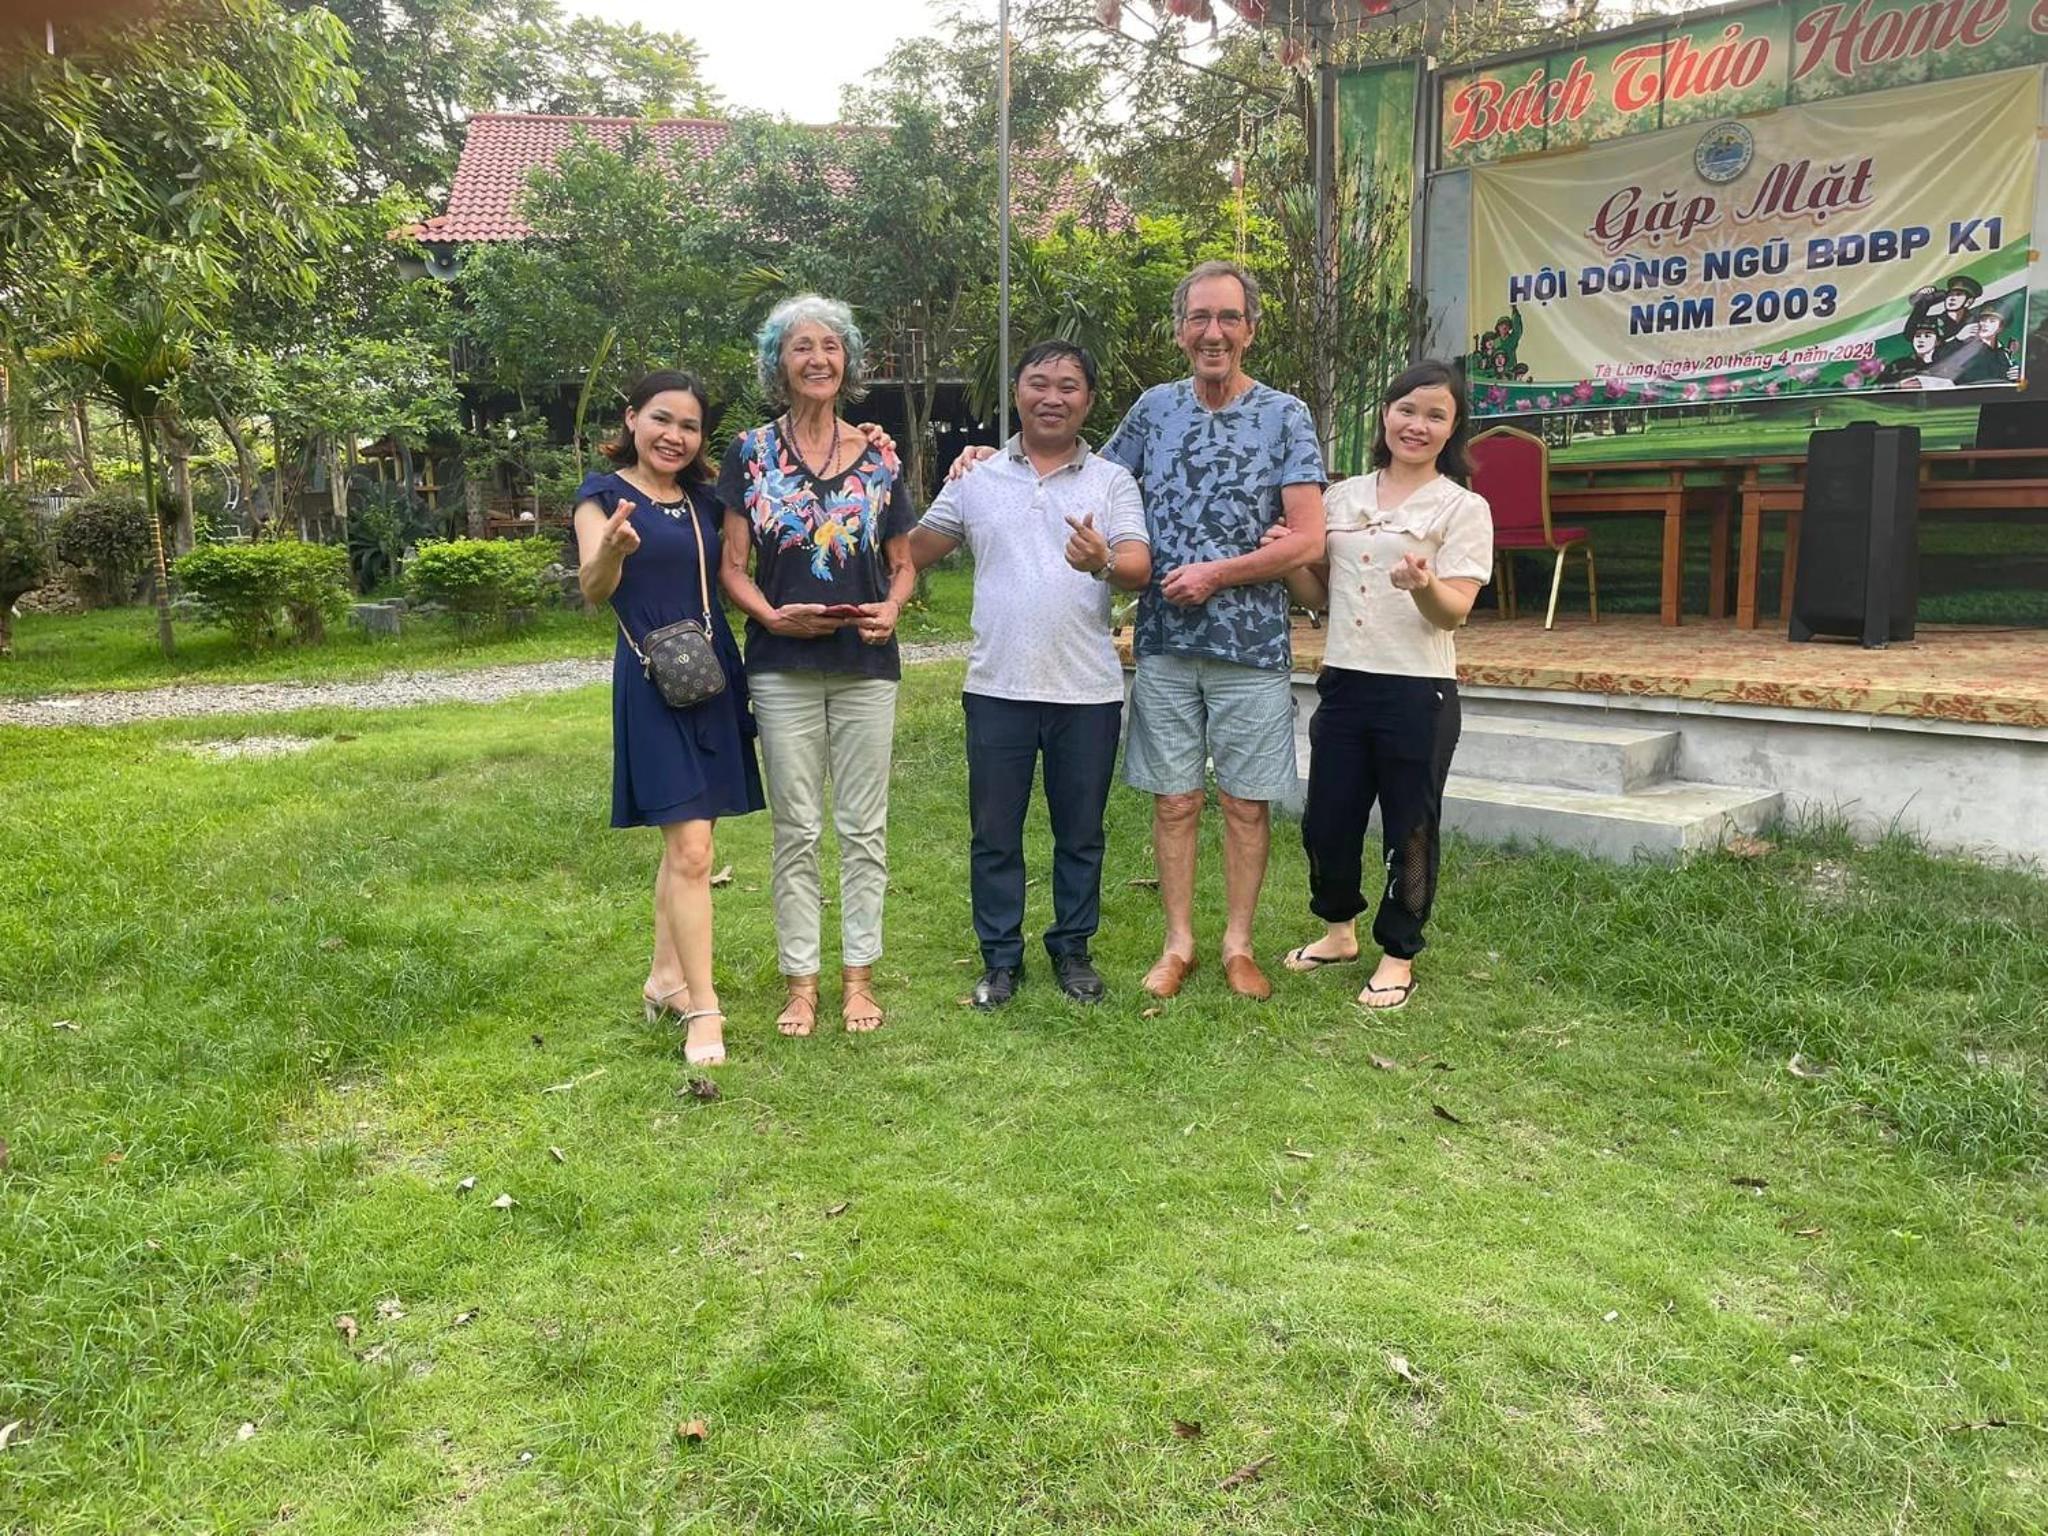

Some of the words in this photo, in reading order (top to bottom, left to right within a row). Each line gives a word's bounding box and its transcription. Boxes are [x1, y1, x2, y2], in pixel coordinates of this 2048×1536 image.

[1451, 57, 1594, 148] Bách
[1611, 22, 1770, 112] Thảo
[1793, 0, 2007, 80] Home
[1589, 186, 1722, 251] Gặp
[1736, 157, 1874, 221] Mặt
[1510, 266, 1567, 307] HỘI
[1578, 253, 1688, 296] ĐỒNG
[1703, 237, 1789, 282] NGŨ
[1948, 217, 2002, 255] K1
[1629, 294, 1714, 335] NĂM
[1729, 285, 1837, 326] 2003
[1662, 358, 1700, 376] ngày
[1705, 355, 1723, 370] 20
[1729, 350, 1773, 370] tháng
[1778, 349, 1788, 364] 4
[1792, 345, 1828, 362] năm
[1833, 341, 1875, 360] 2024
